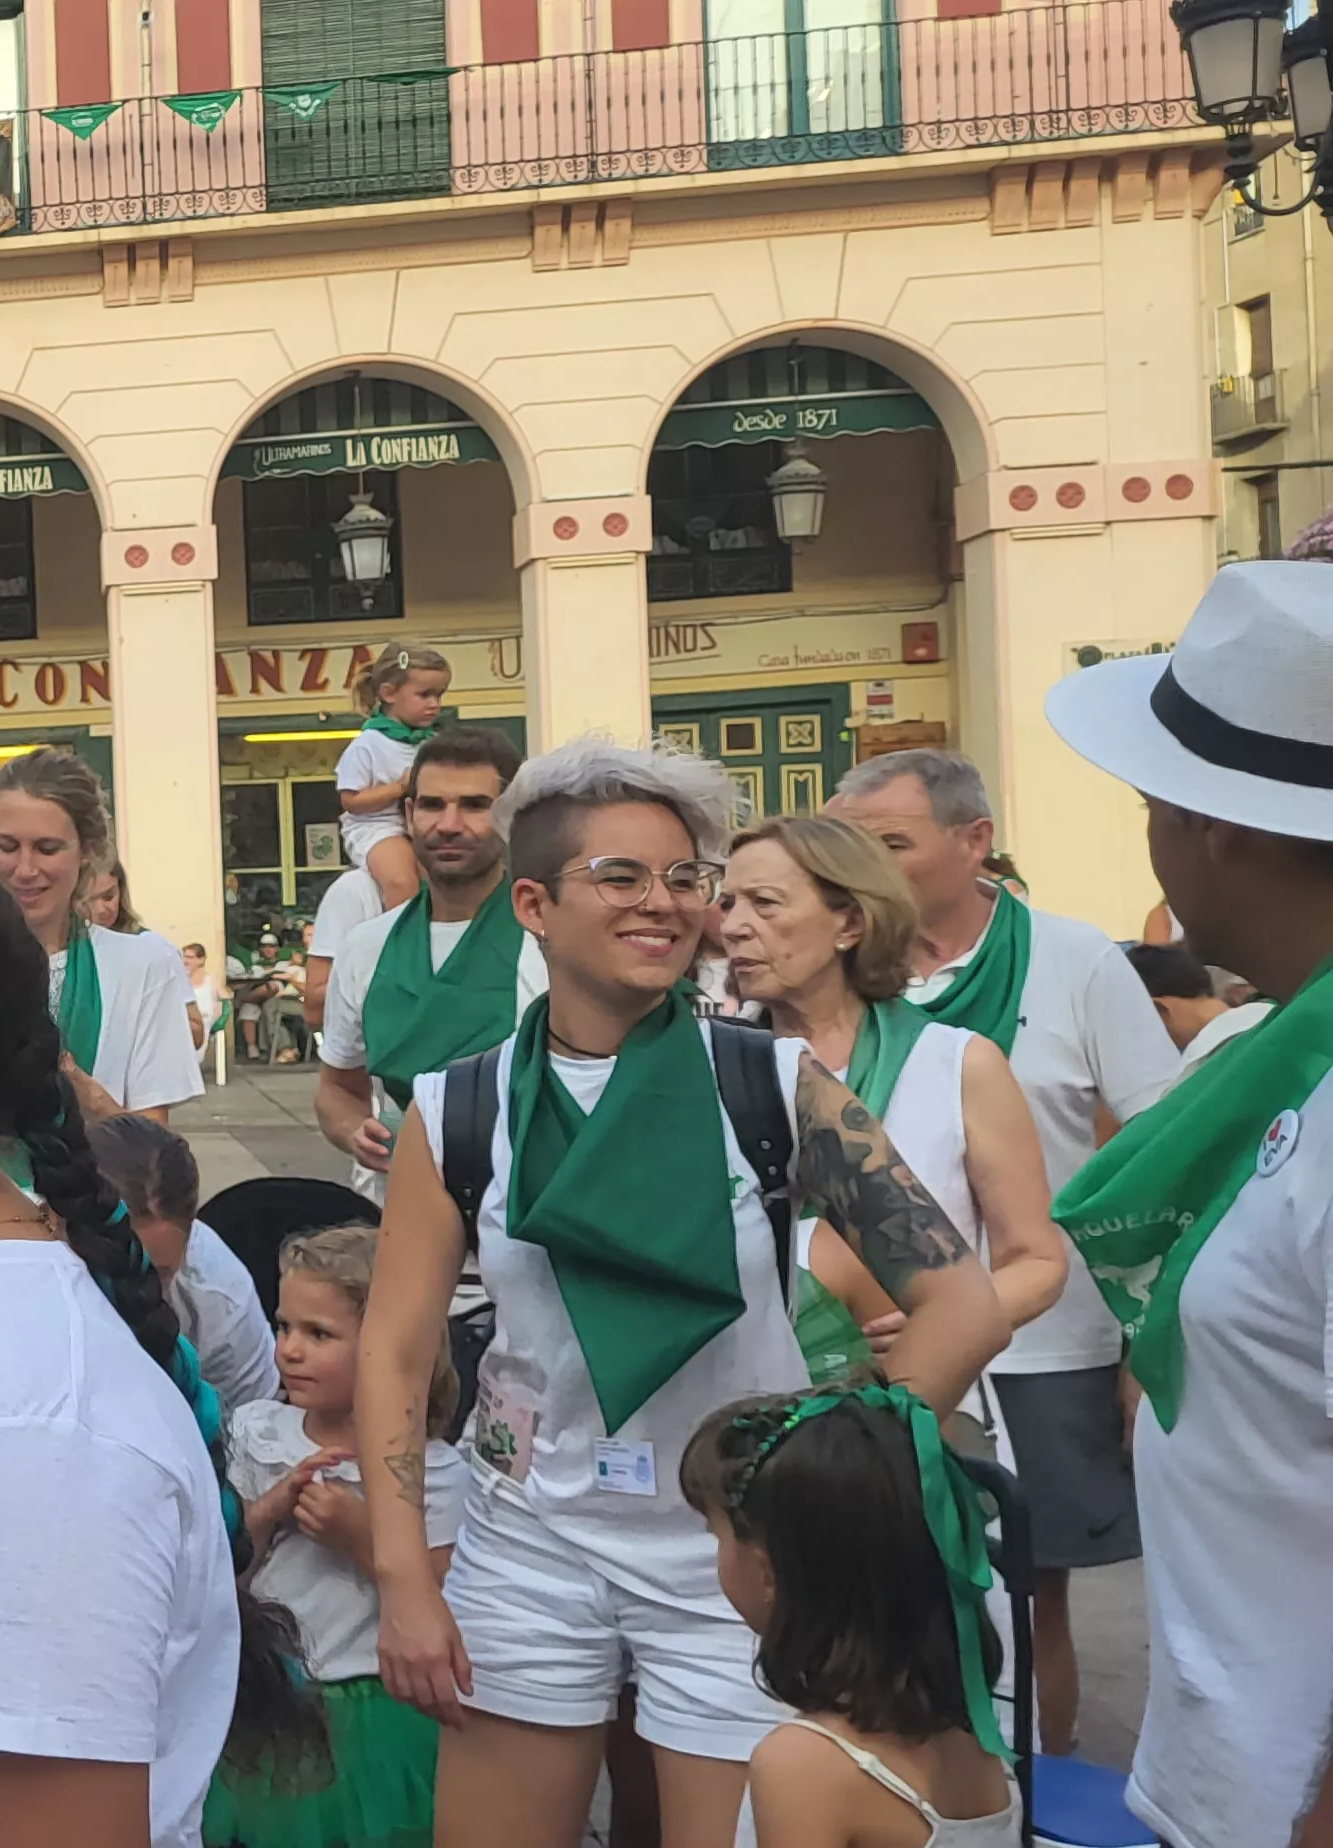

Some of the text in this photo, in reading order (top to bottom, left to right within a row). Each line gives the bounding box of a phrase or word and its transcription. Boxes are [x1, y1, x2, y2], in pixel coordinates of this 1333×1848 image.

[733, 408, 838, 432] desde 1871
[345, 438, 367, 467] LA
[370, 434, 460, 465] CONFIANZA
[650, 622, 718, 657] INOS
